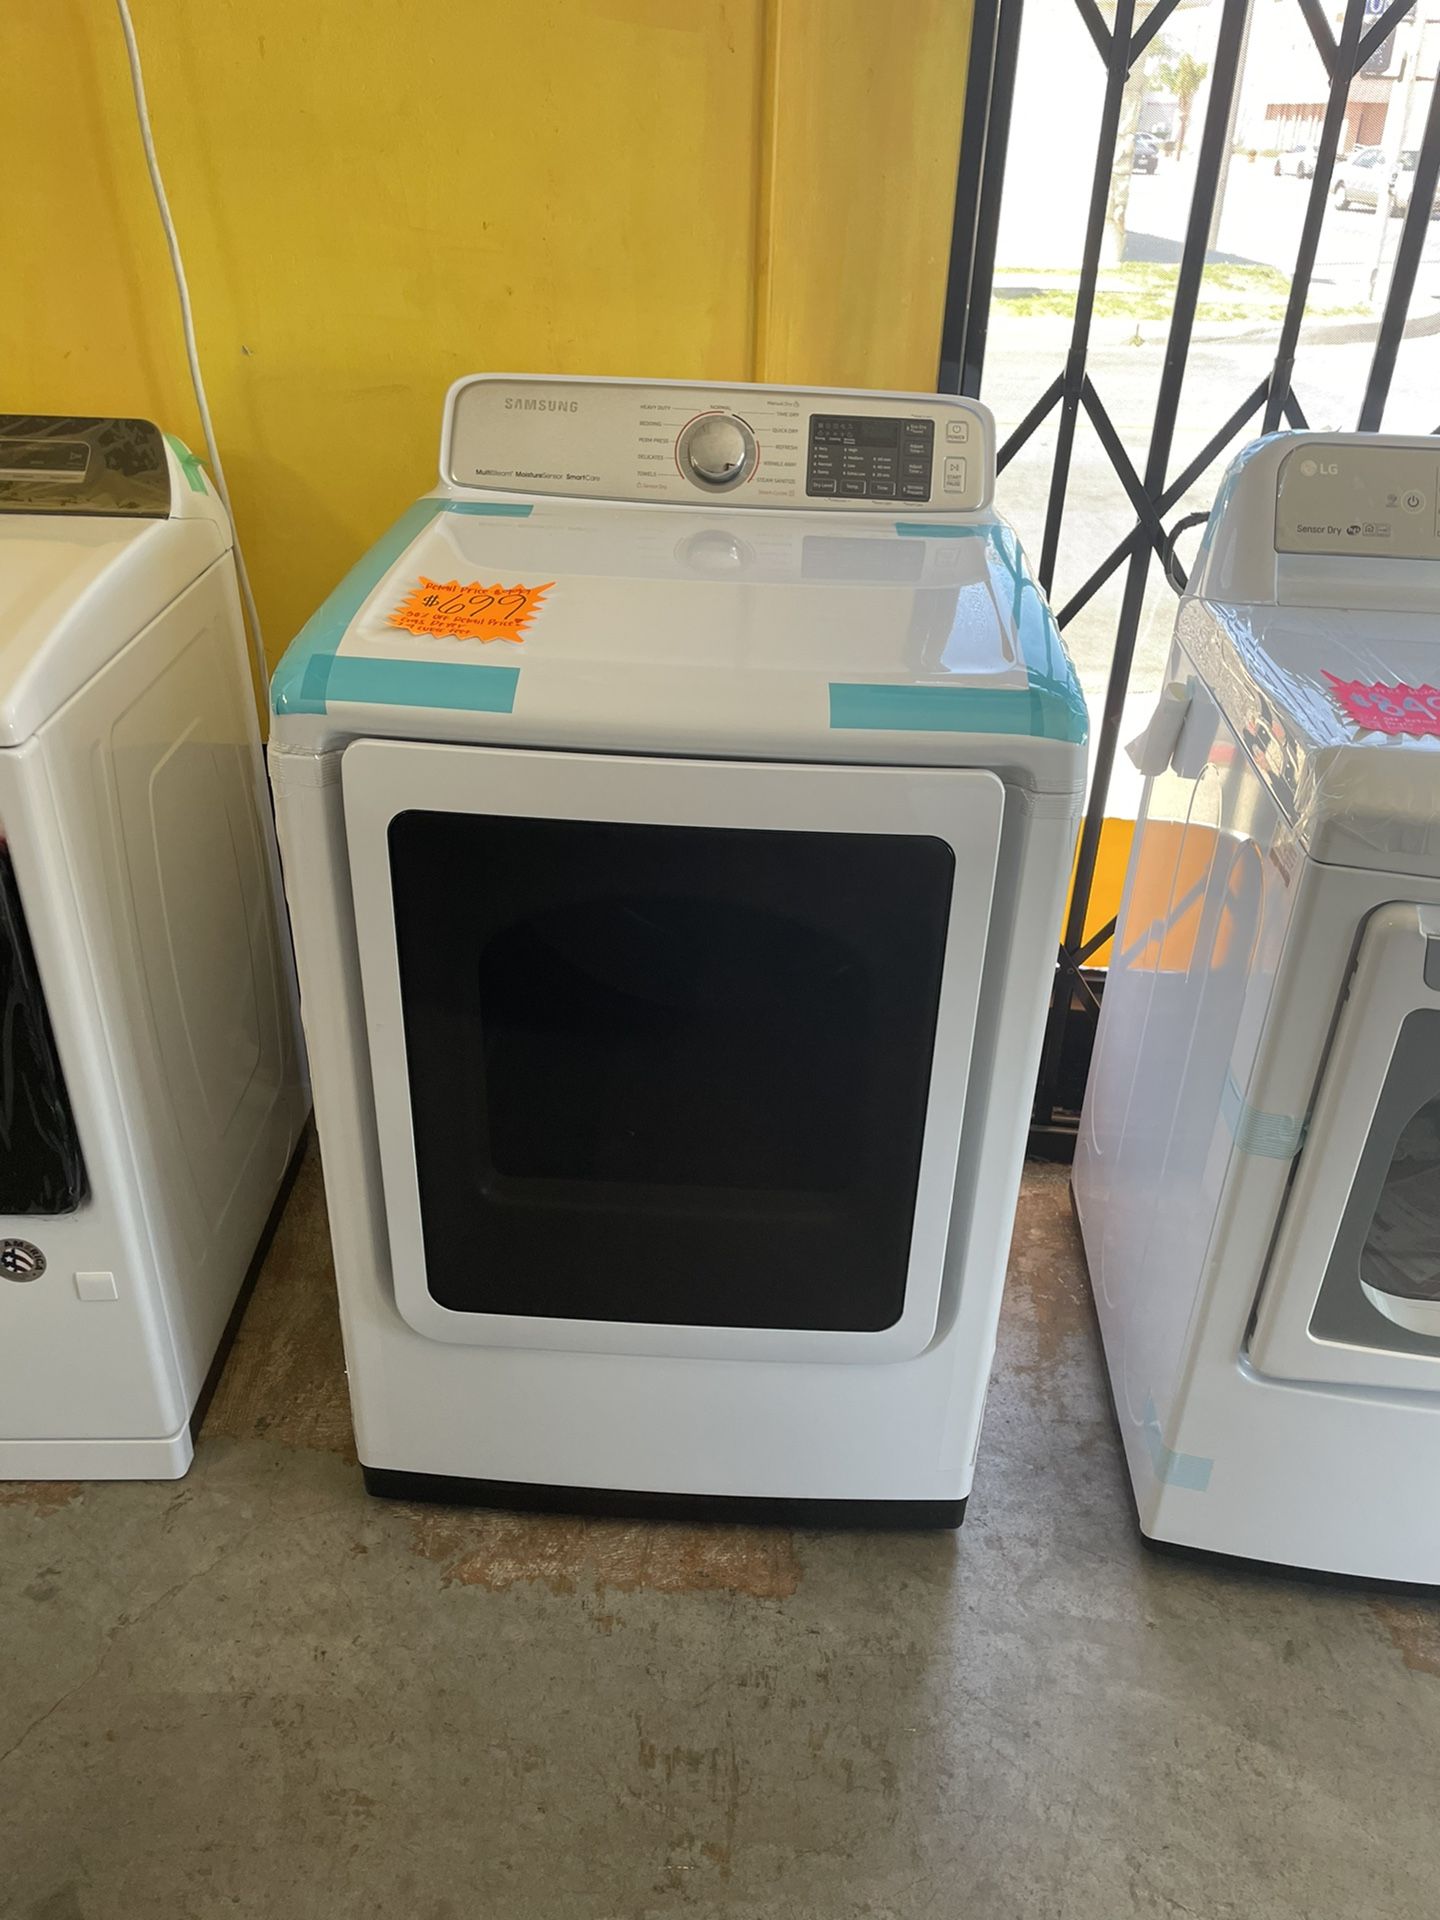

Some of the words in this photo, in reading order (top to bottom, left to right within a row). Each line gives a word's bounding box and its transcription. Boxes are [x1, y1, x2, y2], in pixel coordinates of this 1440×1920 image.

[505, 398, 578, 413] SAMSUNG
[1319, 463, 1338, 475] LG
[515, 471, 563, 480] MoistureSensor
[566, 473, 601, 482] SmartCare
[1296, 524, 1325, 535] Sensor
[1327, 525, 1342, 536] Dry
[422, 593, 527, 620] $699
